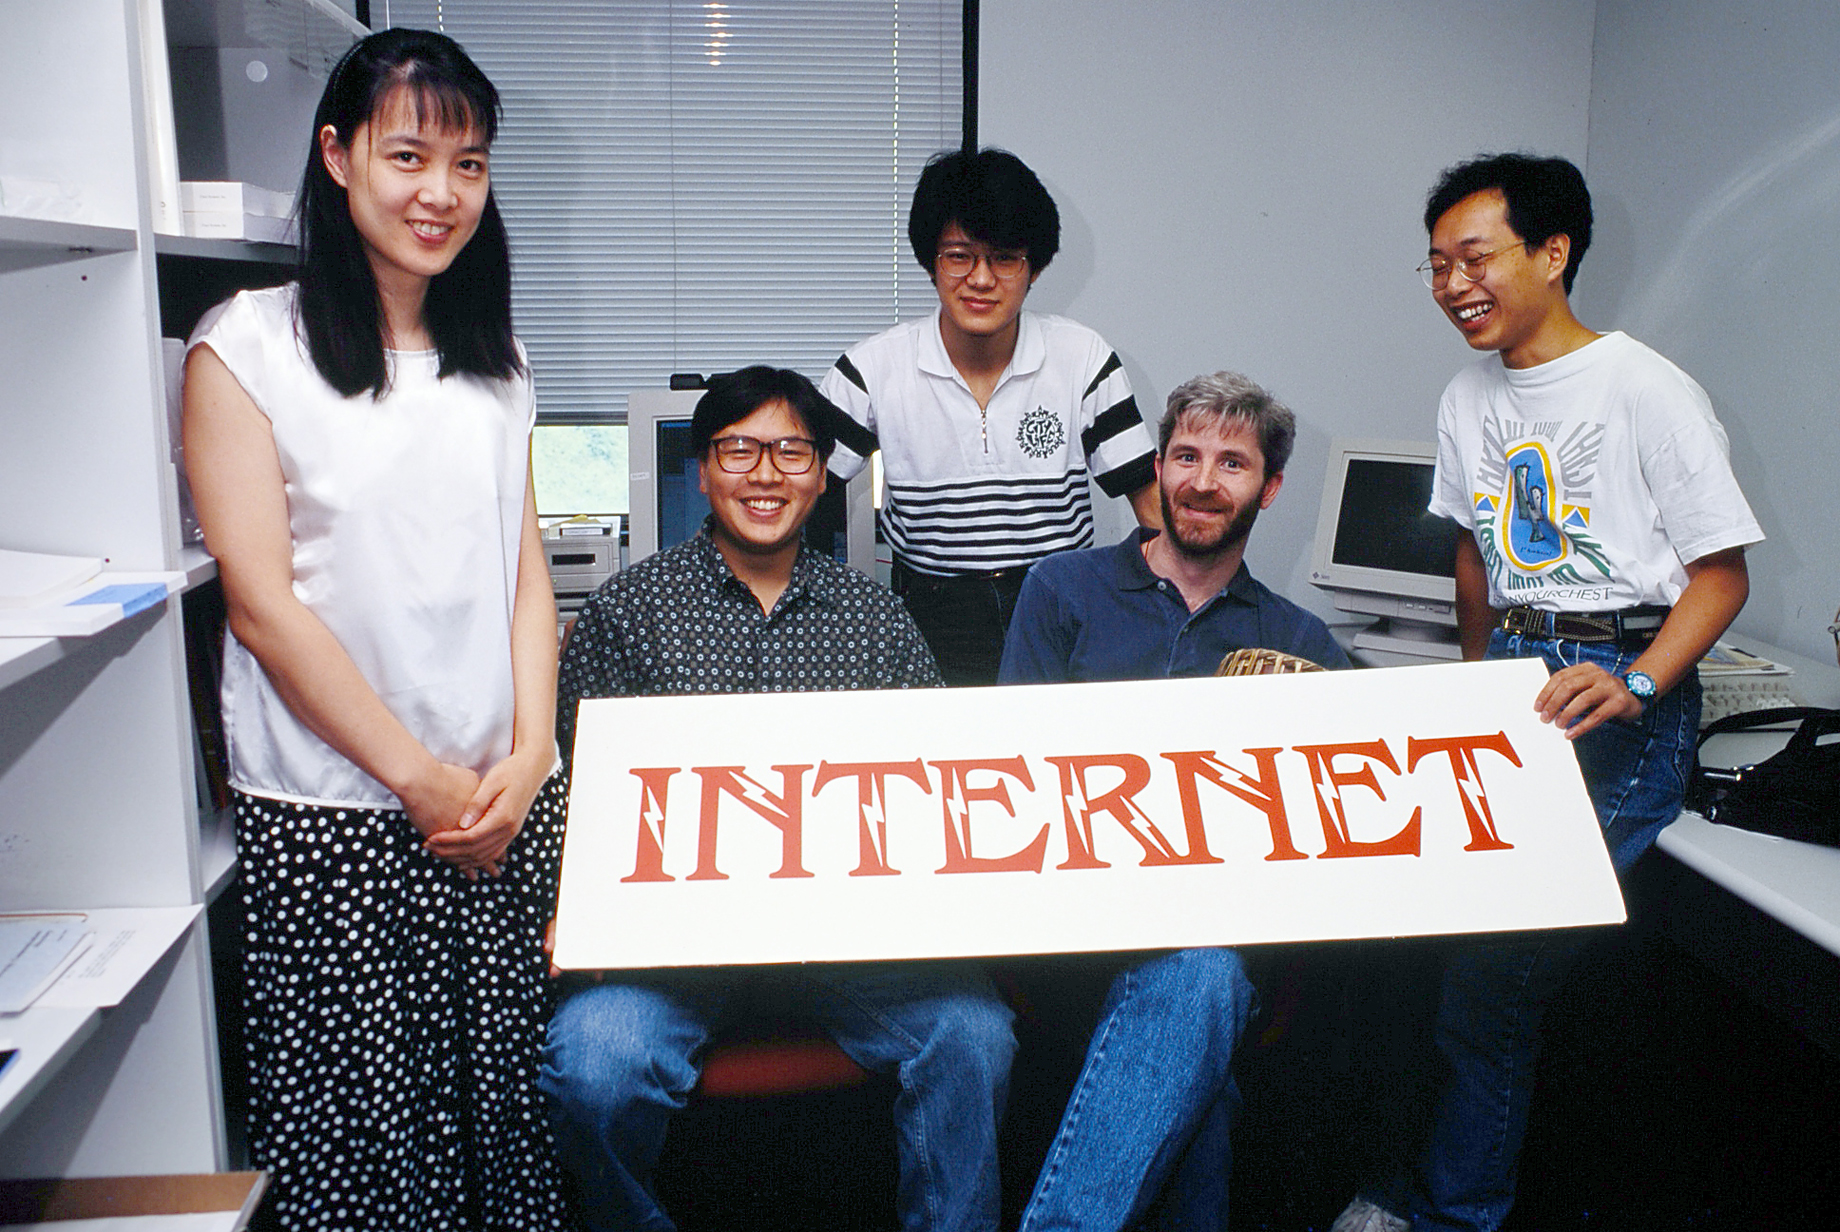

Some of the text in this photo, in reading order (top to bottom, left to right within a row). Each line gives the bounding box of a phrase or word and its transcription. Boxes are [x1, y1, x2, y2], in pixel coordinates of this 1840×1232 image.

[1026, 419, 1053, 434] CITY
[1026, 430, 1055, 448] LIFE
[621, 731, 1523, 882] INTERNET
